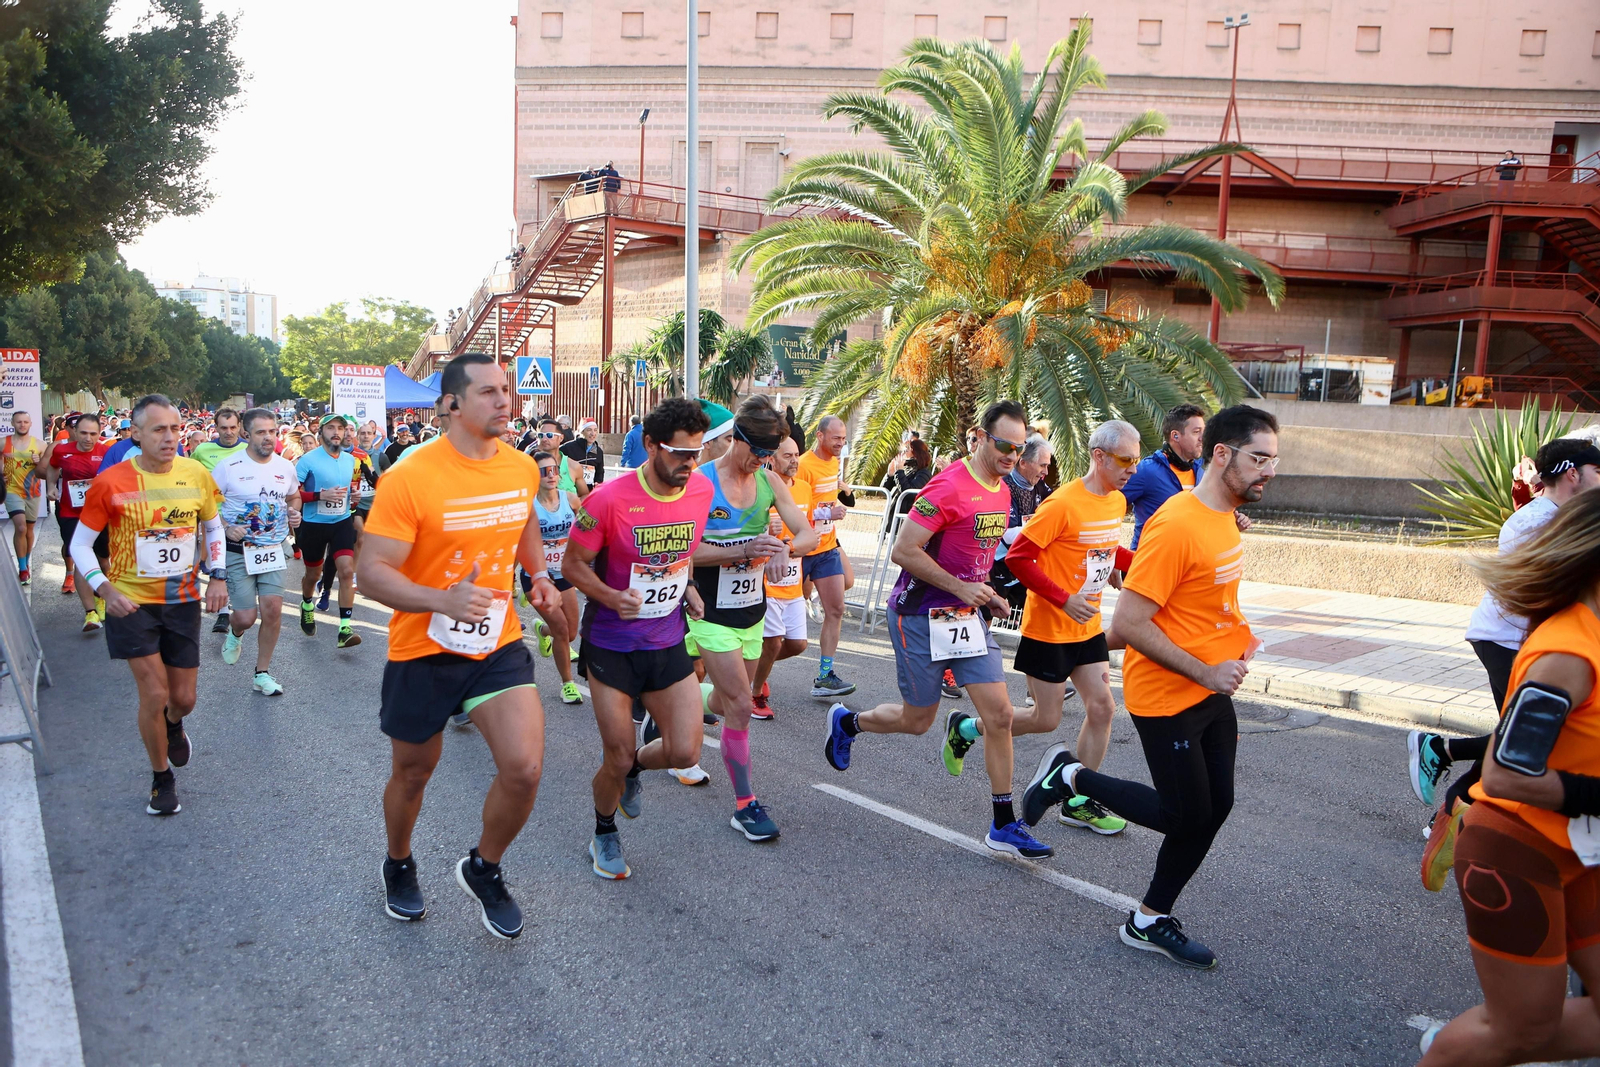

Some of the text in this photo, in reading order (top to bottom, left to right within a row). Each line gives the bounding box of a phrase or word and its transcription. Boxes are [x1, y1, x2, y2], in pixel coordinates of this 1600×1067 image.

[780, 337, 798, 348] Gran
[336, 366, 382, 377] SALIDA
[338, 378, 353, 386] XII
[629, 505, 645, 513] vive
[635, 523, 694, 545] TRISPORT
[642, 540, 688, 555] MALAGA
[158, 547, 181, 564] 30
[254, 551, 277, 565] 845
[731, 578, 757, 595] 291
[644, 584, 678, 605] 262
[949, 626, 970, 644] 74
